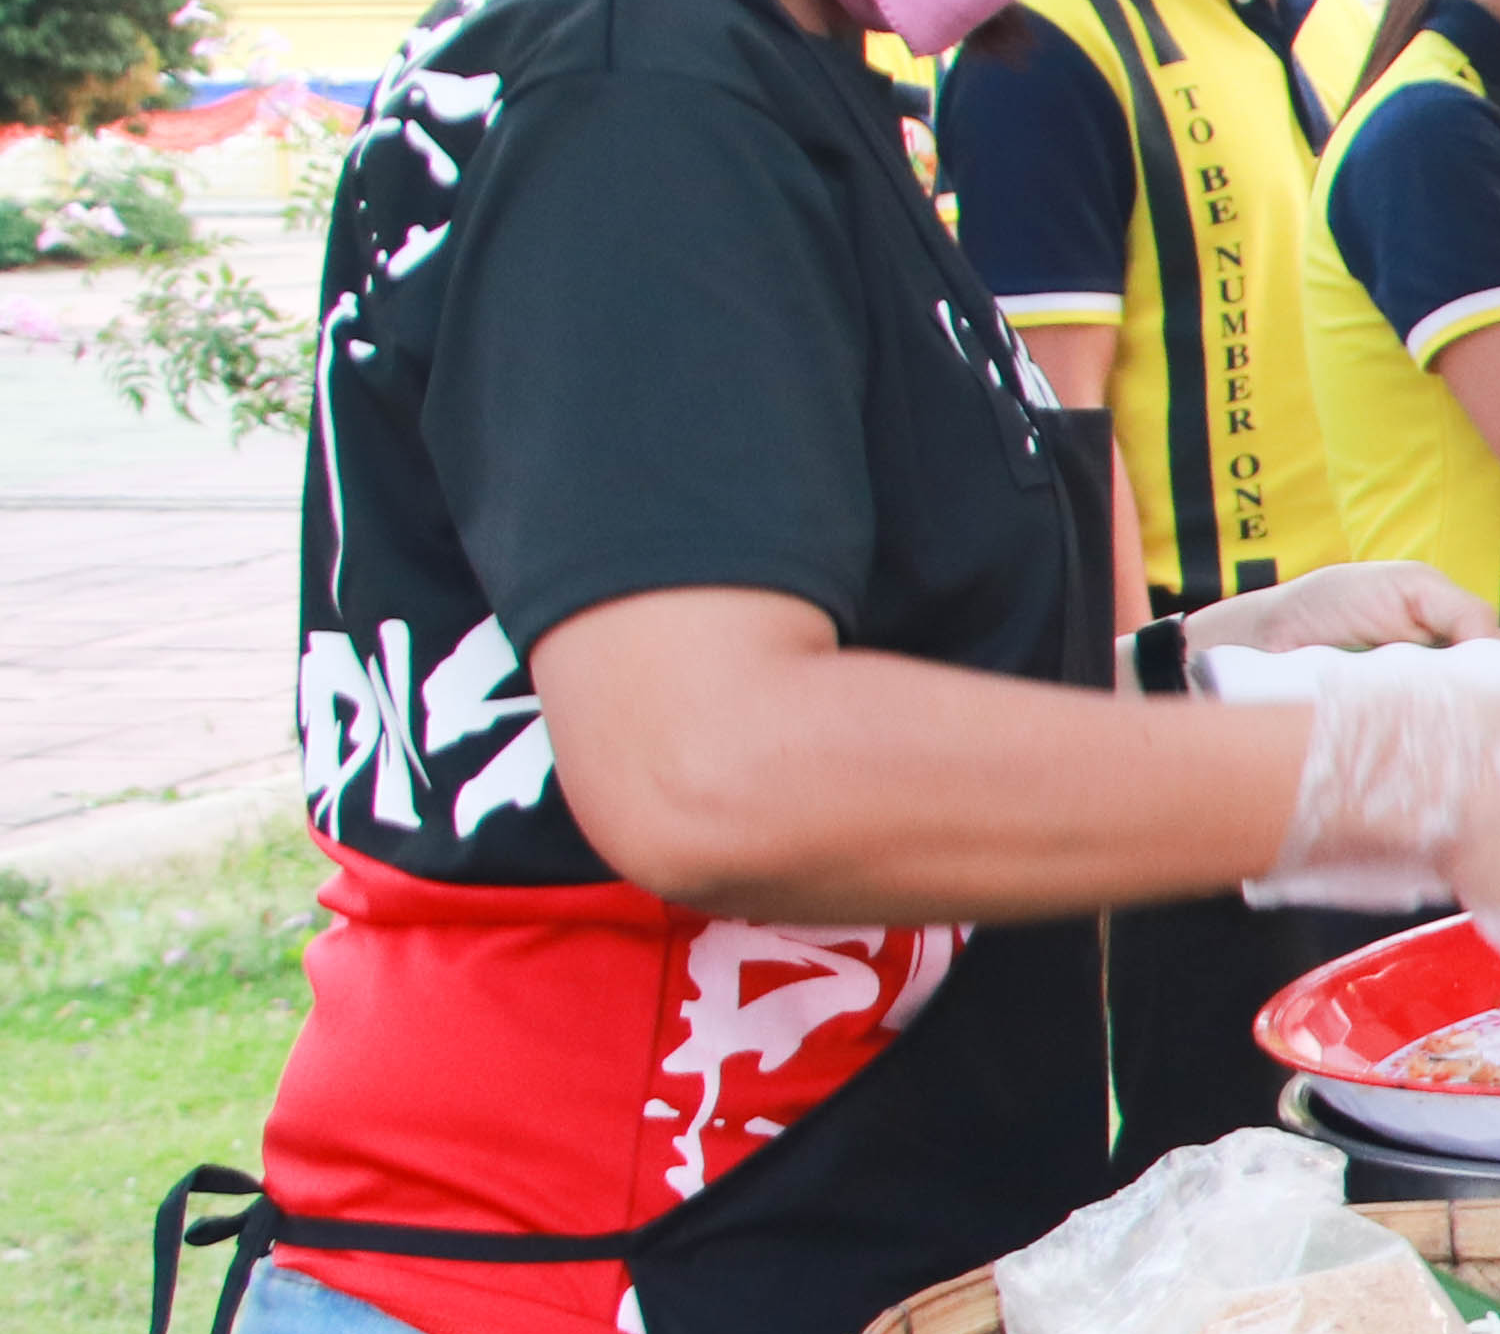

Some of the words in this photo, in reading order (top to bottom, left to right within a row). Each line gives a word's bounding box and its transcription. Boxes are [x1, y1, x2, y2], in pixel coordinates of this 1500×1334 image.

[1174, 85, 1214, 145] TO
[1199, 165, 1239, 226] BE
[1214, 241, 1256, 435] NUMBER
[1230, 452, 1268, 540] ONE
